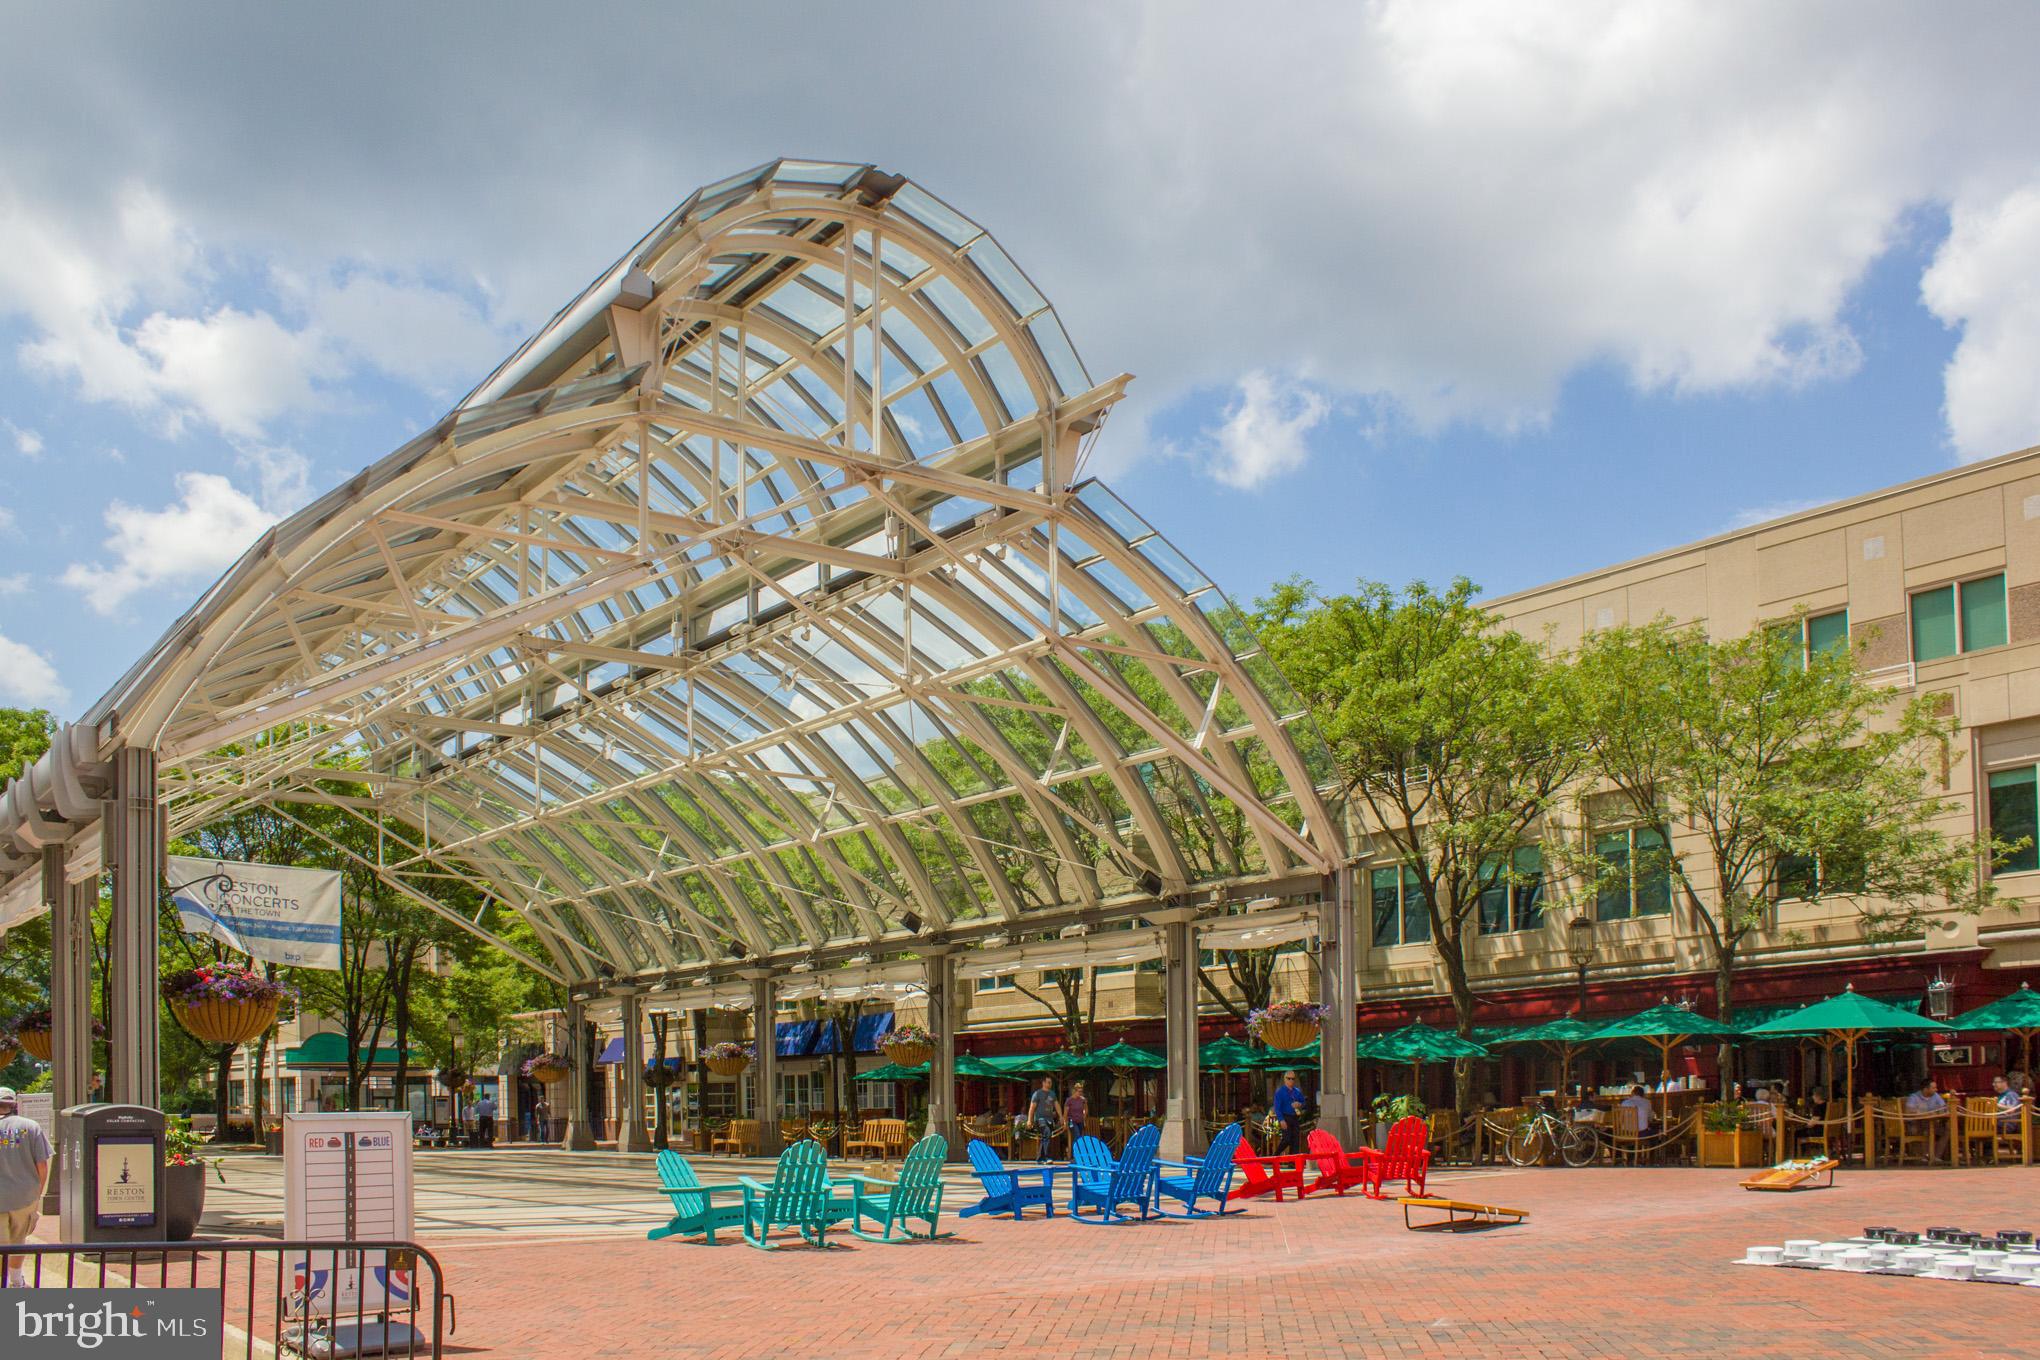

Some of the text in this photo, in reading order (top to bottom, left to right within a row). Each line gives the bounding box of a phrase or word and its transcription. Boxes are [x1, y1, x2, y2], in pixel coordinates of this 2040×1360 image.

[219, 893, 299, 910] CONCERTS
[237, 907, 253, 915] THE
[255, 908, 281, 917] TOWN
[284, 952, 301, 962] bxp
[309, 1136, 390, 1148] RED BLUE
[107, 1187, 145, 1196] RESTON
